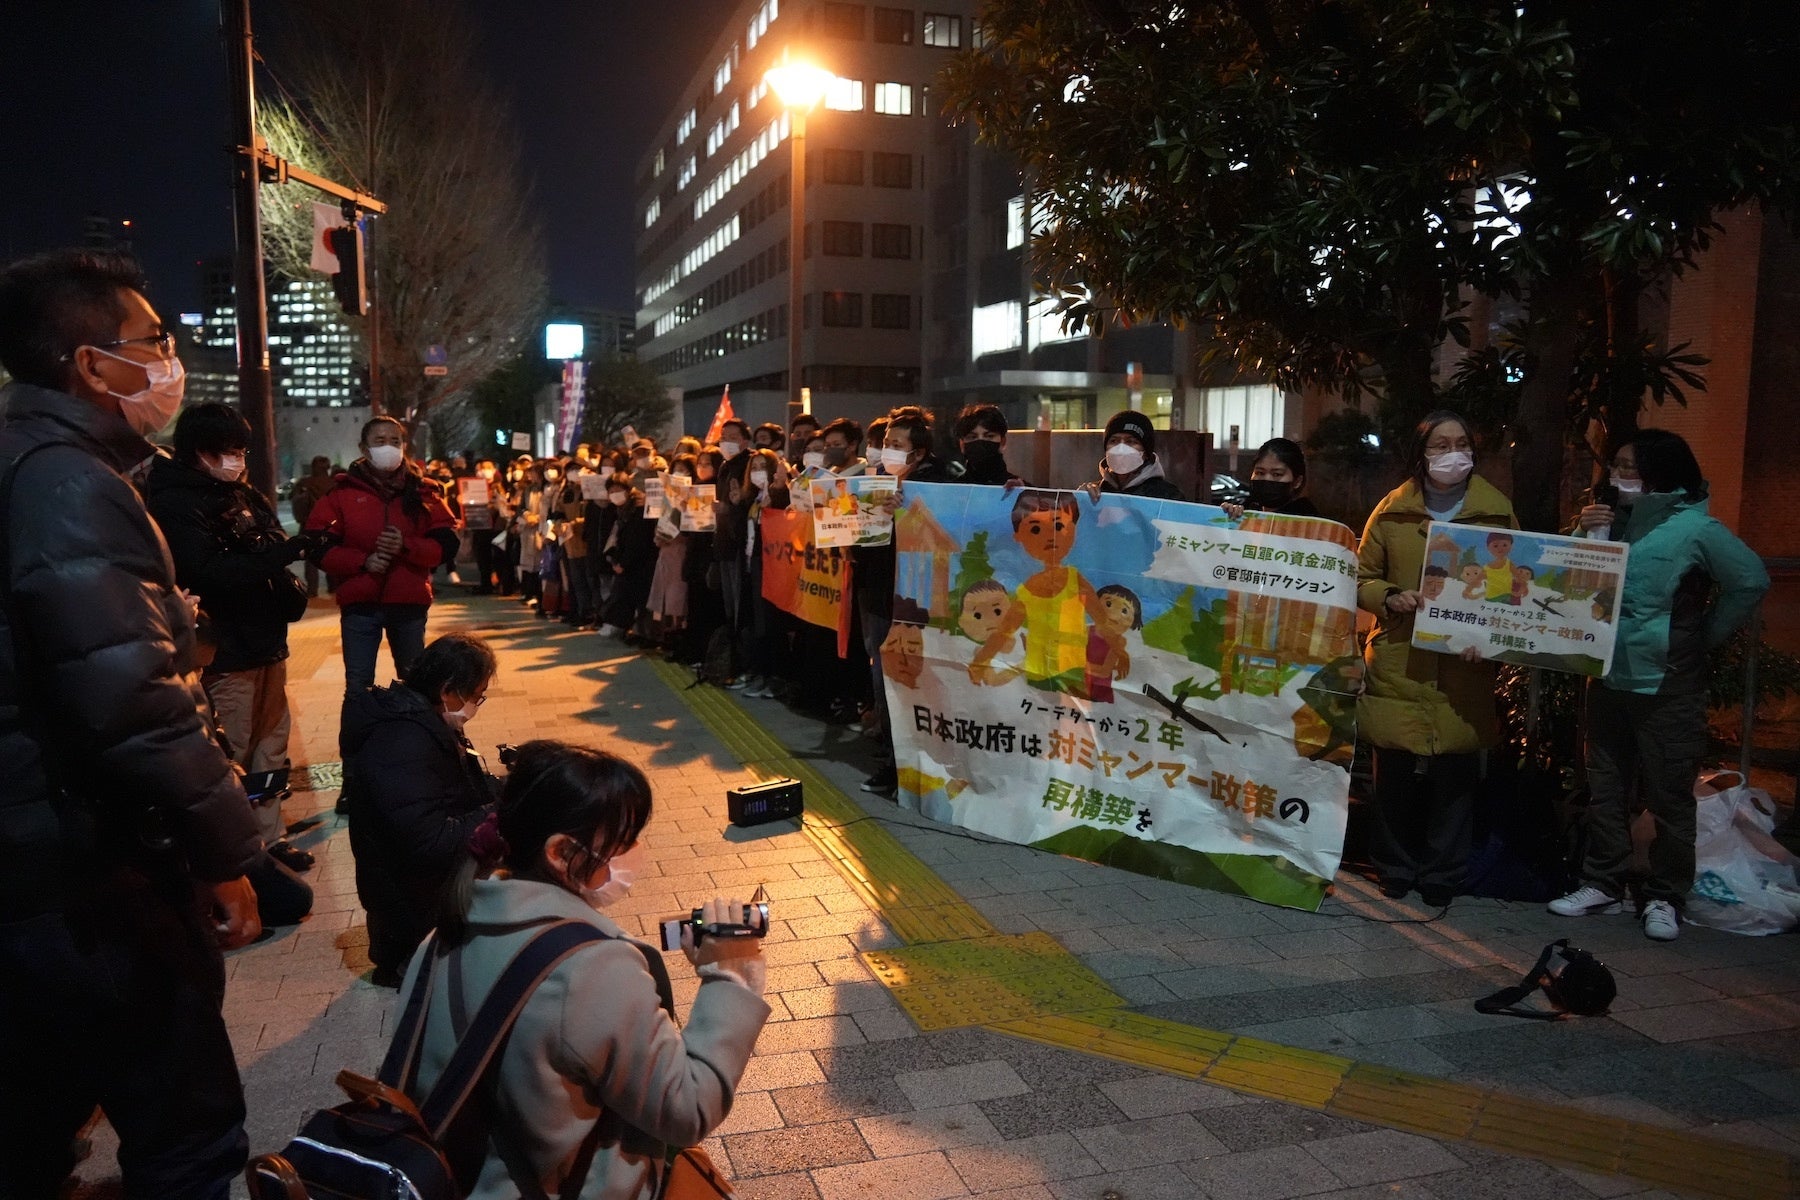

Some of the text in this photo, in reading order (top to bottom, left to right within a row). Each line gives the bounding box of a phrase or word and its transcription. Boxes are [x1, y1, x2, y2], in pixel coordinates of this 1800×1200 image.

[1212, 565, 1336, 594] @官邸前アクション
[1429, 607, 1595, 643] 日本政府は対ミャンマー政策の
[1489, 632, 1537, 650] 再構築を
[1020, 698, 1185, 751] クーデターから2年
[913, 705, 1310, 824] 日本政府は対ミャンマー政策の
[1041, 777, 1153, 833] 再構築を
